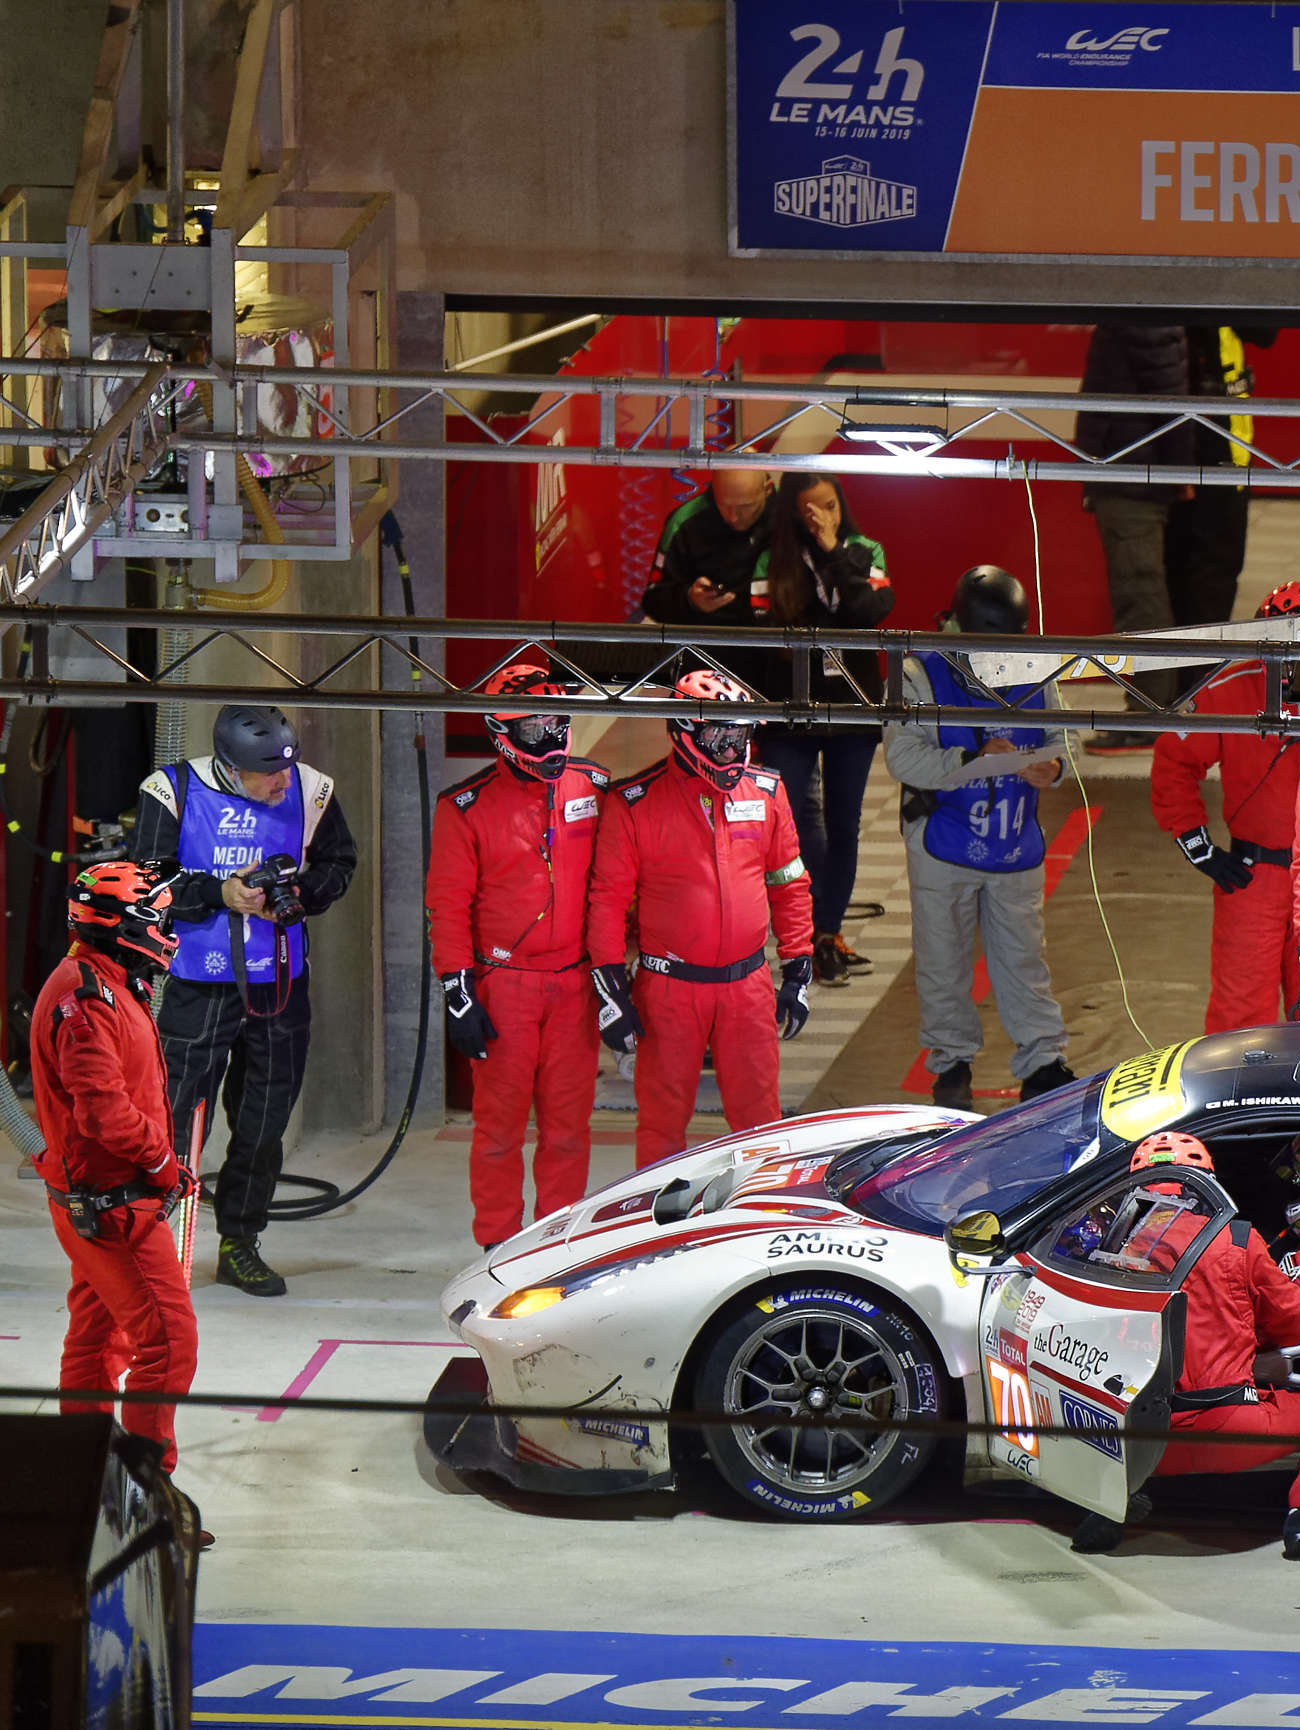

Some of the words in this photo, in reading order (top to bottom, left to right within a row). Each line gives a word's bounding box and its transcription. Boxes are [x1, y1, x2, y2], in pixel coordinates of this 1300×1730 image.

[1065, 26, 1170, 51] WEC
[775, 23, 925, 101] 24h
[769, 102, 812, 123] LE
[816, 104, 916, 127] MANS
[814, 126, 847, 138] 15-16
[850, 128, 878, 139] JUIN
[881, 128, 912, 140] 2019
[777, 175, 914, 225] SUPERFINALE
[969, 796, 1025, 840] 914
[213, 846, 263, 865] MEDIA
[1222, 1099, 1239, 1108] M.
[767, 1244, 884, 1262] SAURUS
[790, 1288, 876, 1314] MICHELIN
[1000, 1338, 1026, 1366] TOTAL
[1034, 1331, 1048, 1353] the
[1048, 1323, 1109, 1382] Garage
[990, 1360, 1034, 1451] 70
[585, 1419, 645, 1441] MICHELIN
[1064, 1400, 1119, 1453] CORNES
[1008, 1449, 1035, 1476] WEC
[753, 1484, 836, 1514] MICHELIN
